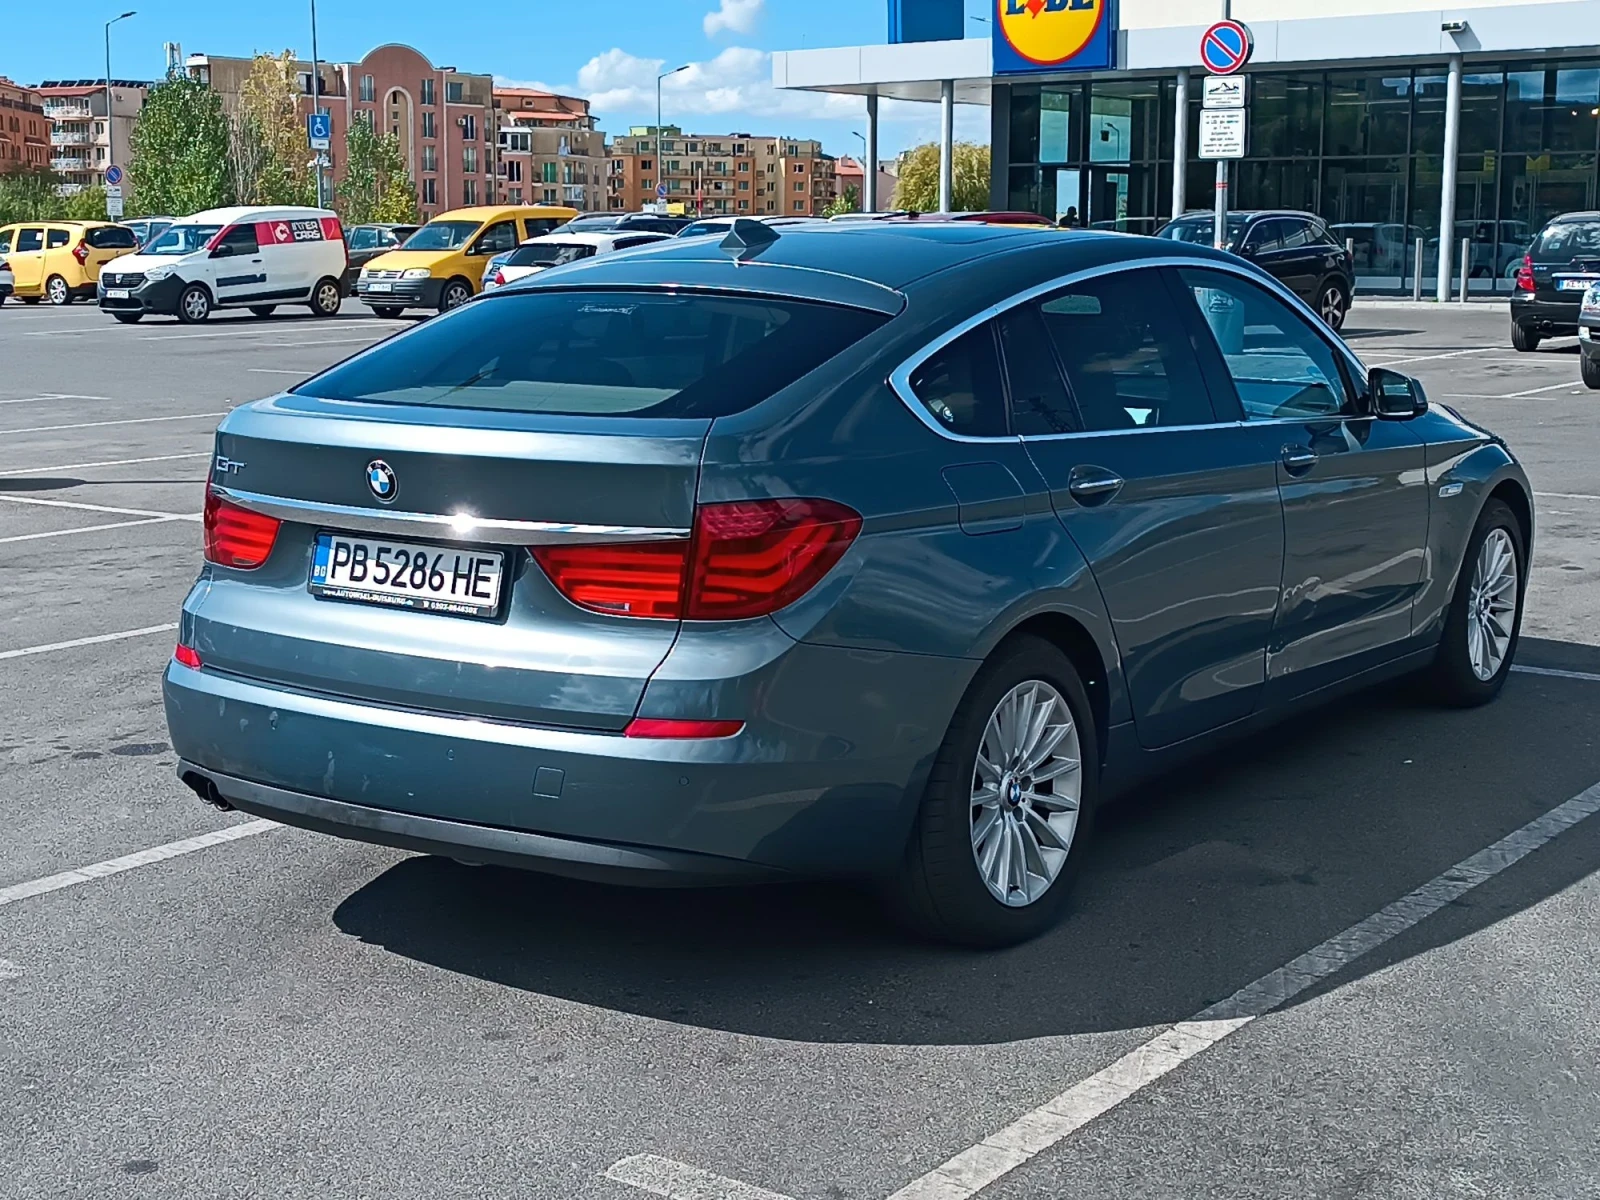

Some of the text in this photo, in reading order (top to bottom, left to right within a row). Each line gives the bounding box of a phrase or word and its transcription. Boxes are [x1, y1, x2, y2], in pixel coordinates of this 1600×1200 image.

[292, 221, 318, 230] INTER
[294, 231, 320, 239] CARS
[216, 455, 245, 474] GT
[314, 564, 326, 577] BG
